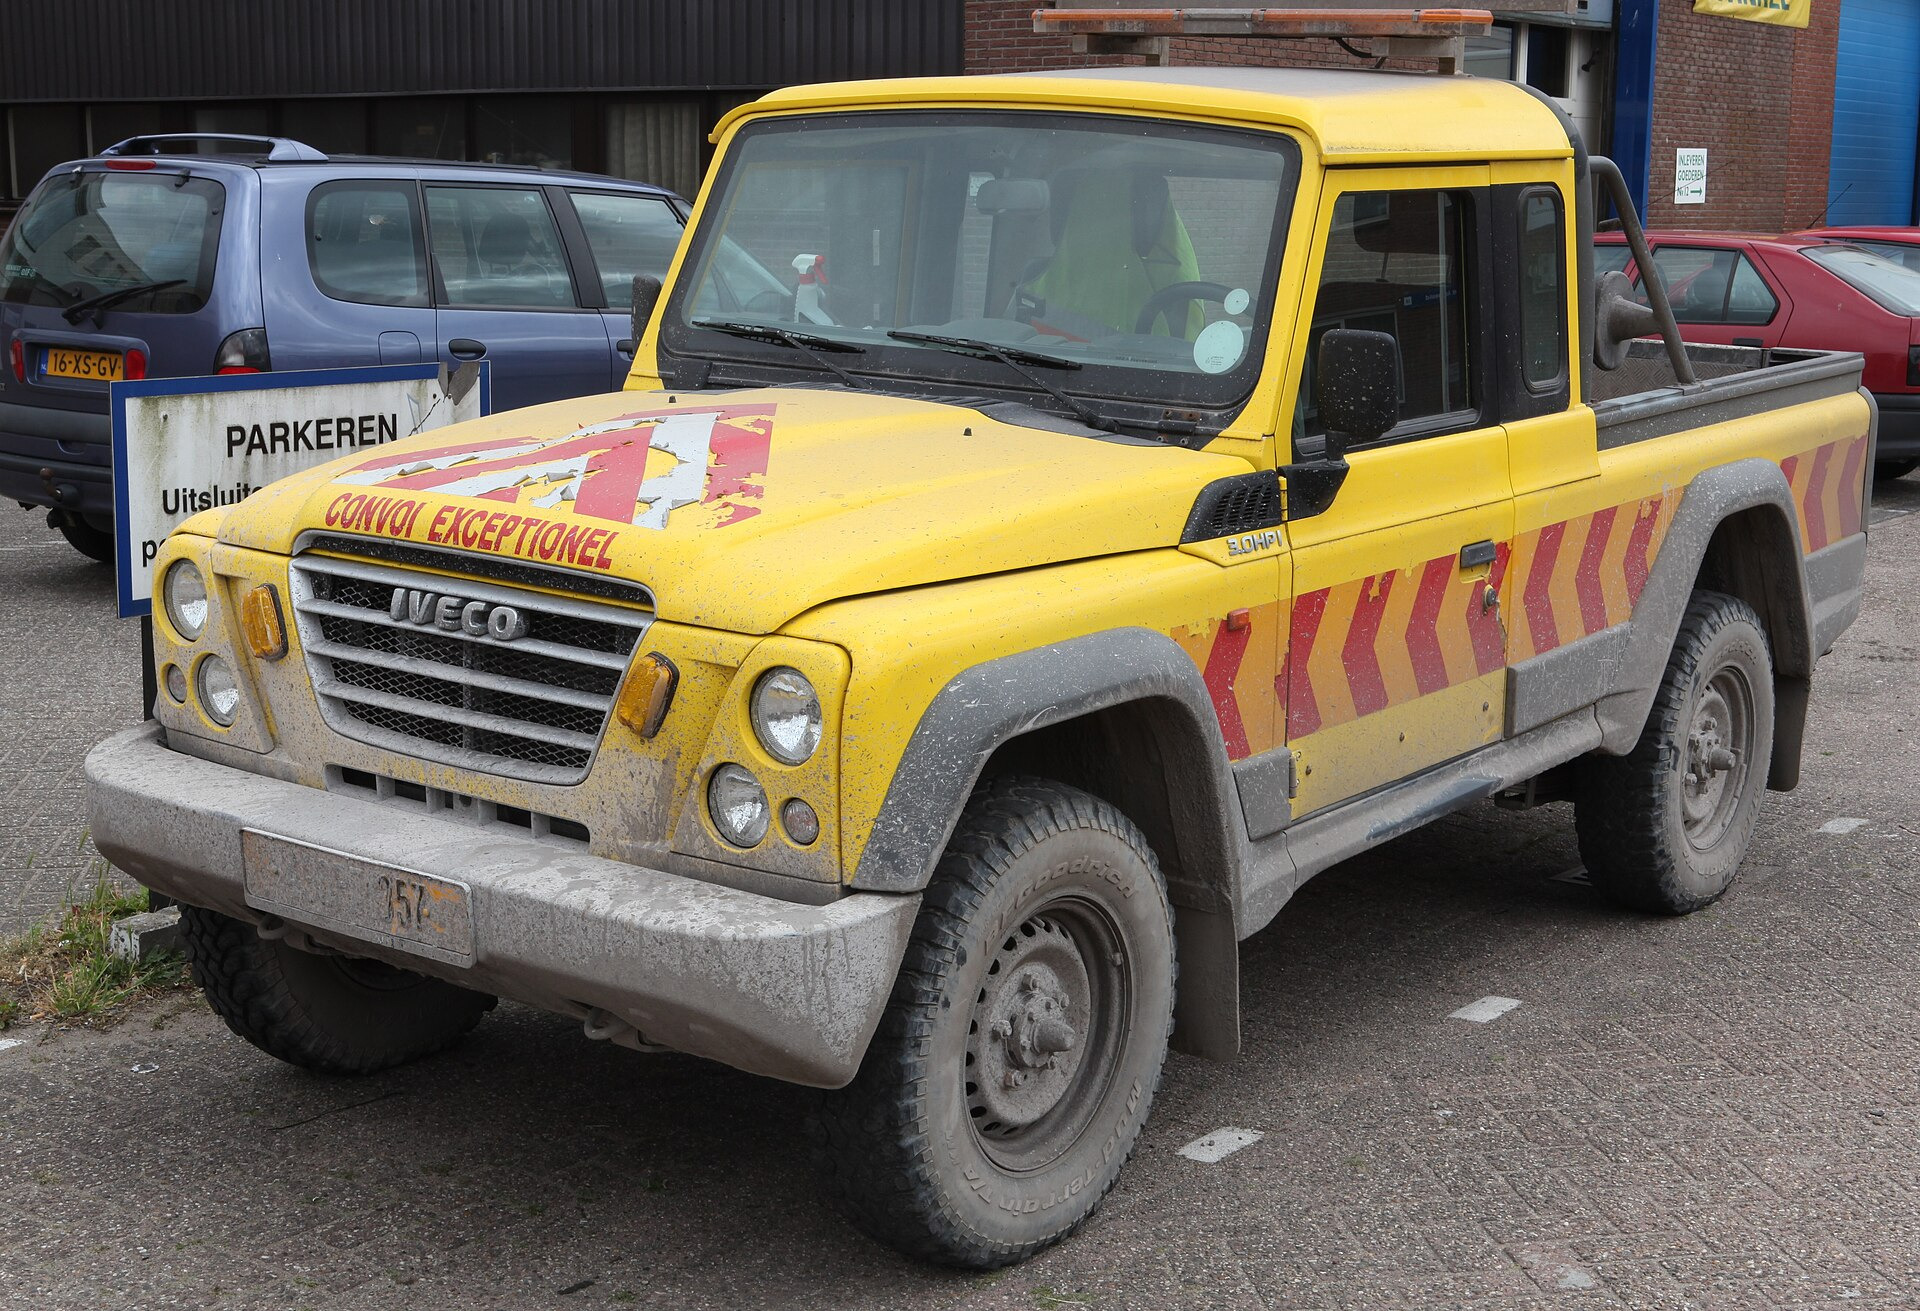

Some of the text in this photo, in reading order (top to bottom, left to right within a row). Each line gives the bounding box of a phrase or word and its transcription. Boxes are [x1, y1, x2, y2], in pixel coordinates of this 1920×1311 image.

[1677, 169, 1704, 181] GOEDEREN
[1678, 154, 1705, 166] INLEVEREN
[53, 352, 119, 377] 16-XS-GV
[226, 413, 398, 458] PARKEREN
[162, 482, 263, 515] Uitsluit
[325, 492, 620, 570] CONVOI EXCEPTIONEL
[390, 587, 530, 641] IVECO
